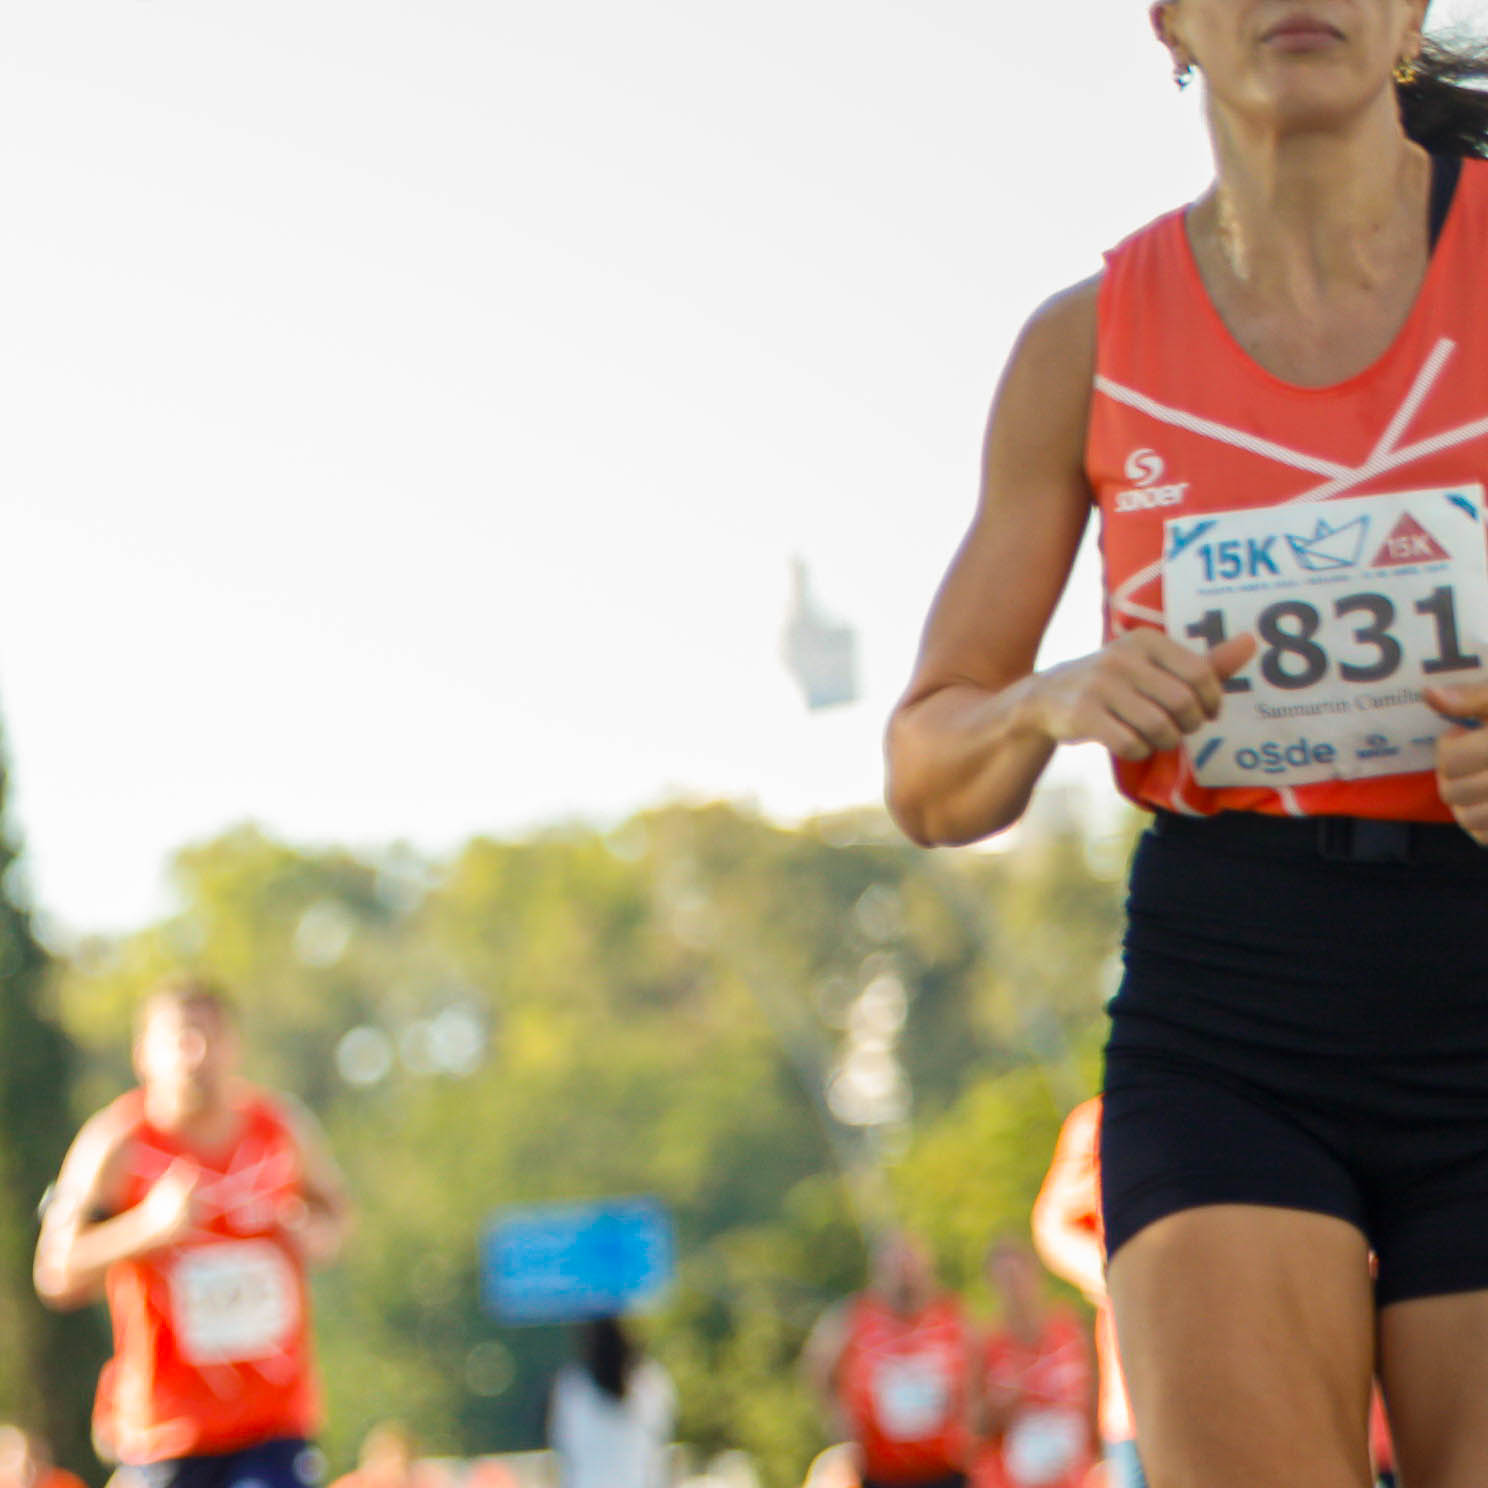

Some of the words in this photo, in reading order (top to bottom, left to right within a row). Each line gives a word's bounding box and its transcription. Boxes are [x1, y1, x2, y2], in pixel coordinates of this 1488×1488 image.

[1198, 534, 1281, 583] 15K
[1185, 584, 1481, 693] 1831
[1235, 735, 1337, 773] osde
